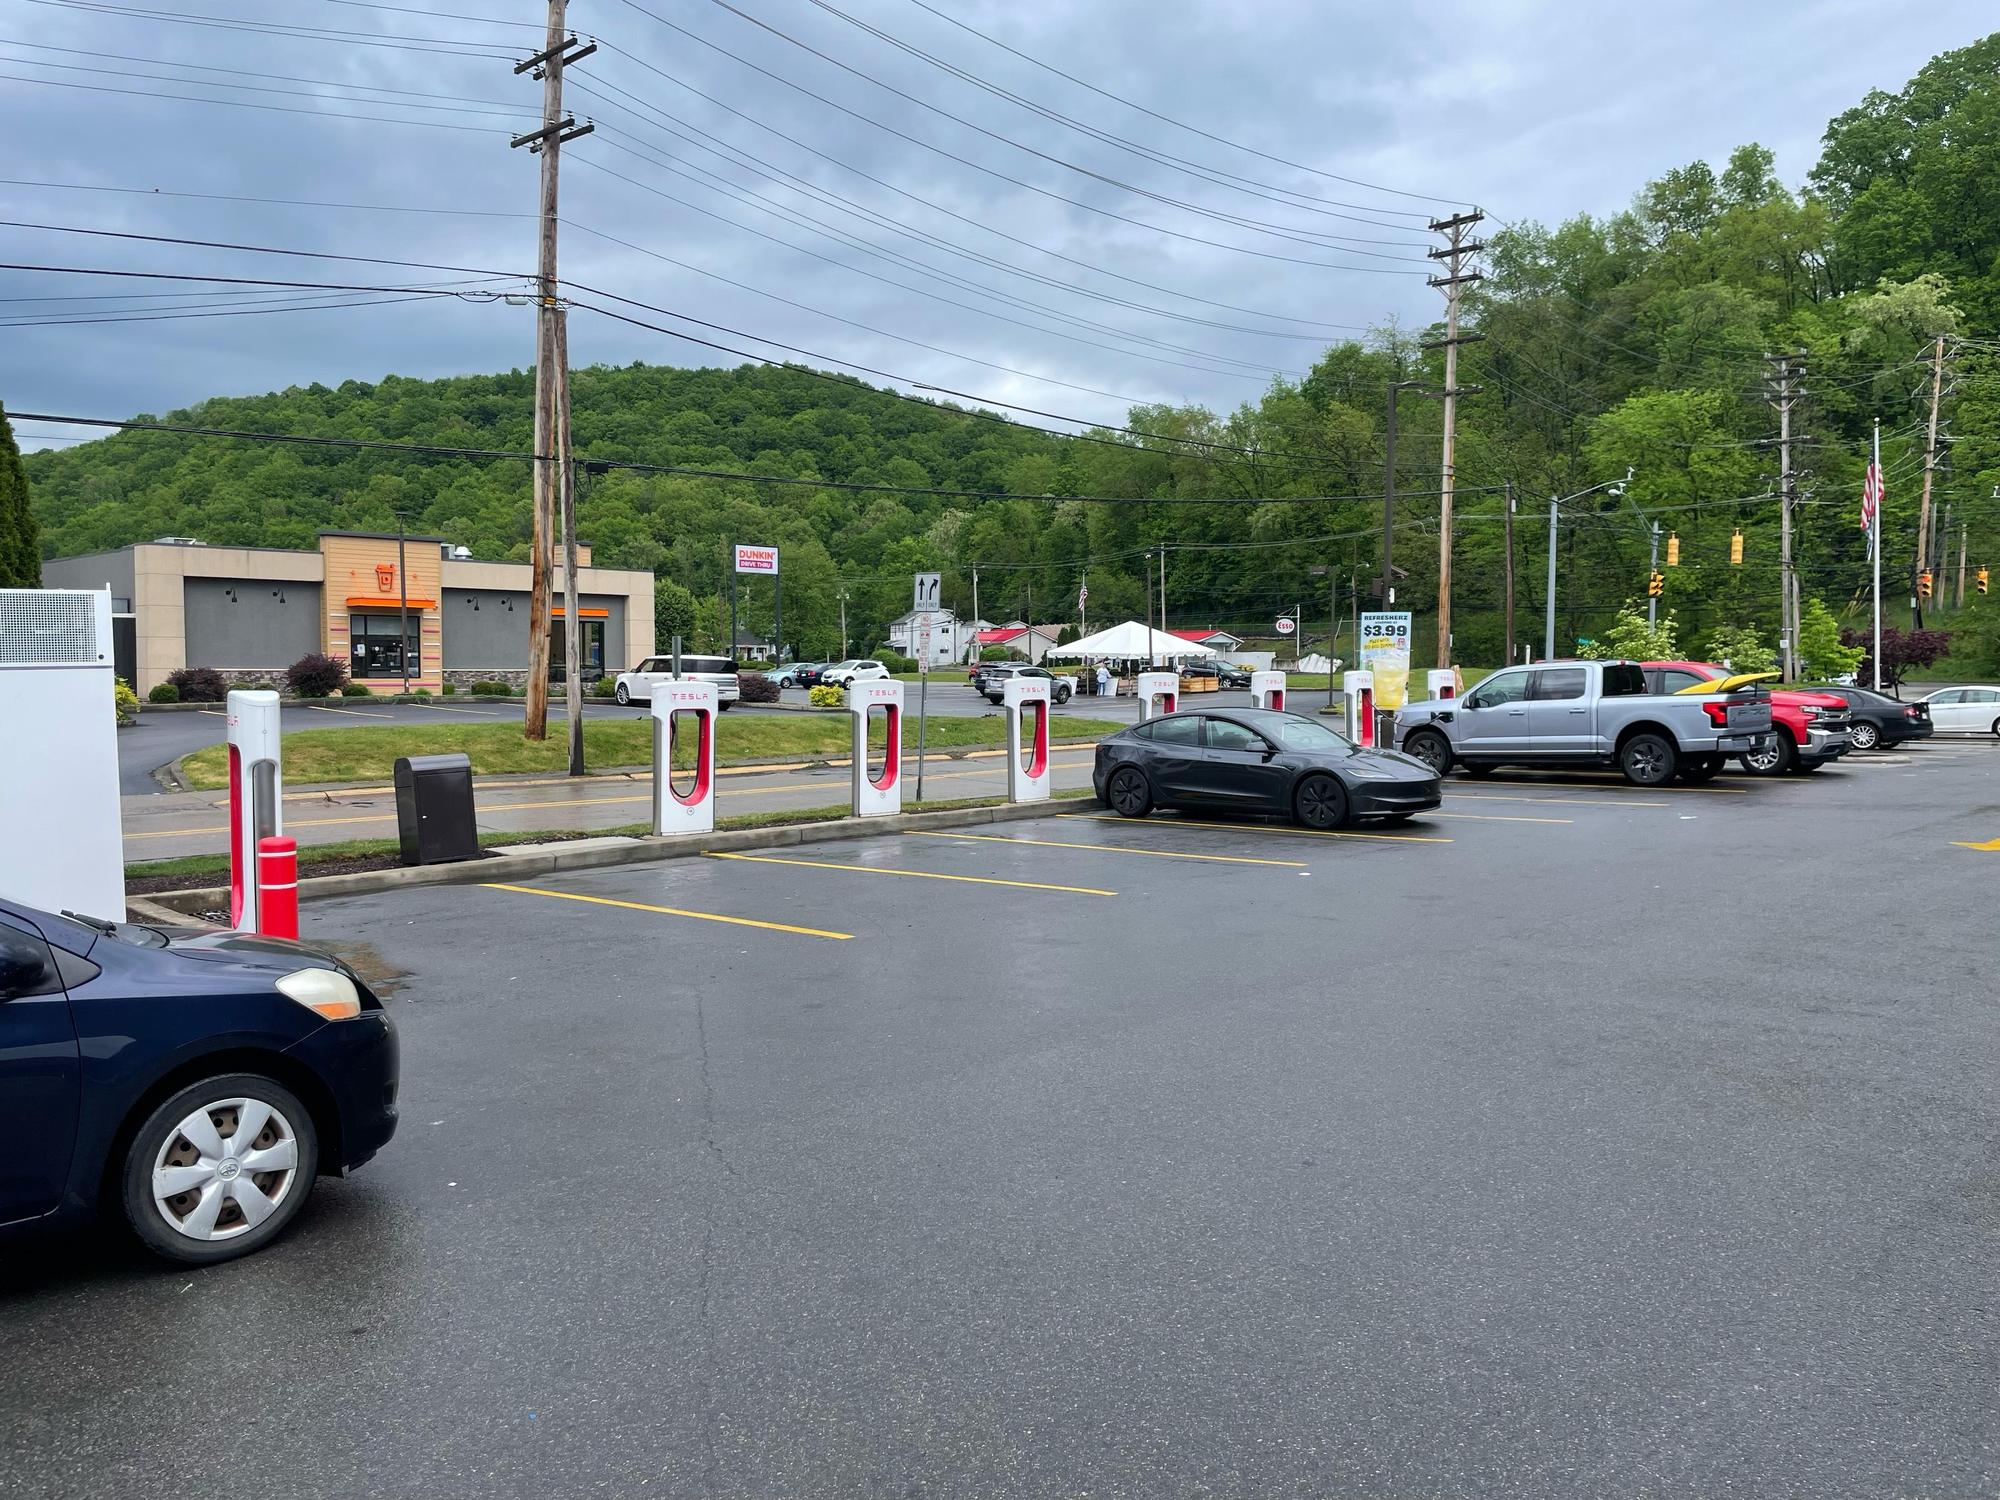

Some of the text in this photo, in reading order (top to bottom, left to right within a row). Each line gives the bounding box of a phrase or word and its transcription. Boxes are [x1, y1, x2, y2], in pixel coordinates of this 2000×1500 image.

[739, 549, 776, 560] DUNKIN'
[740, 560, 771, 569] DRIVE THRU
[1277, 621, 1294, 630] Esso
[1364, 625, 1408, 637] $3.99
